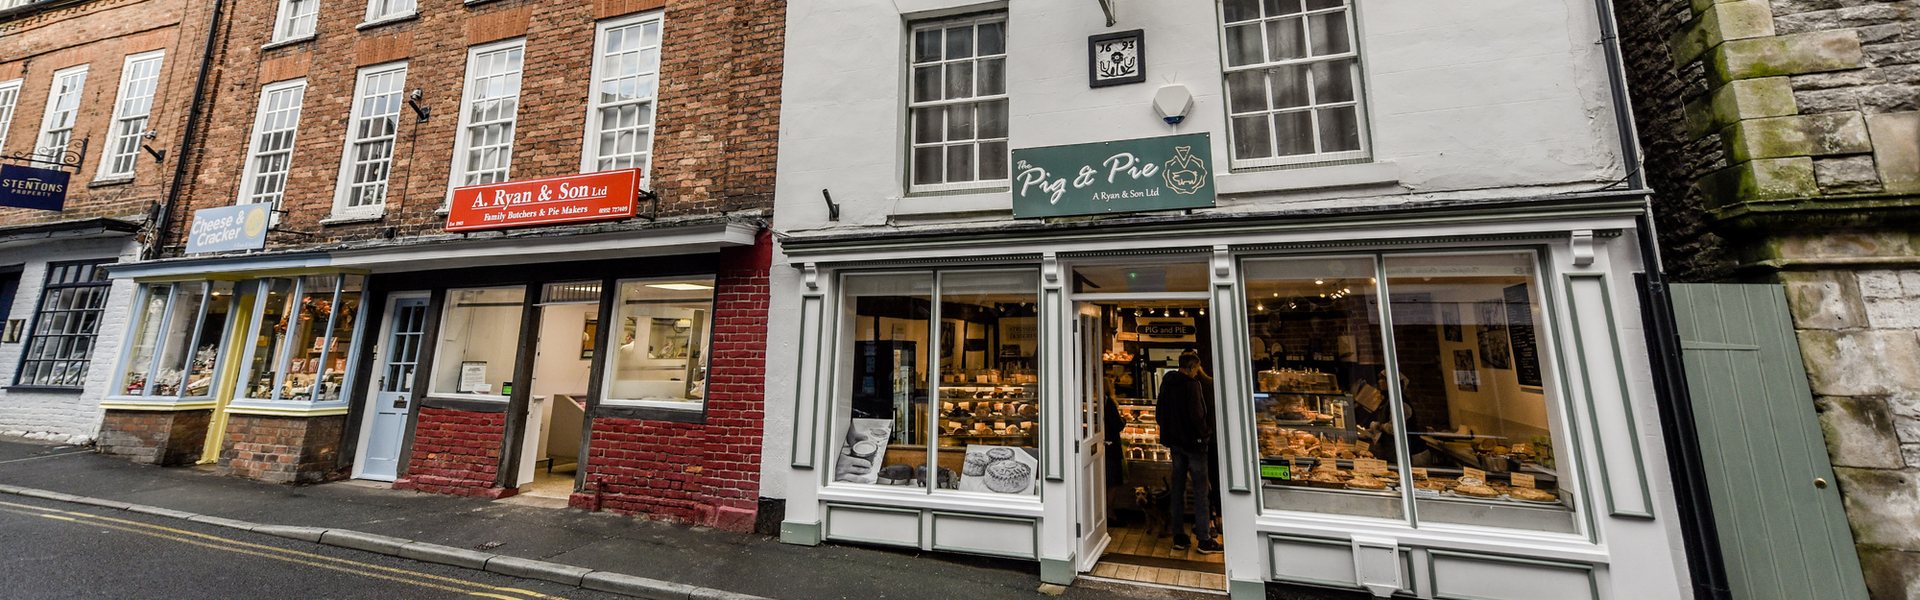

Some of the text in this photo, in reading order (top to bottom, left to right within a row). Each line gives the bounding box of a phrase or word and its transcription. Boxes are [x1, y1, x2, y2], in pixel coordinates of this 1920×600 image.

[1016, 159, 1033, 170] The
[2, 178, 63, 193] STENTONS
[1017, 152, 1159, 205] Pig & Pie
[10, 188, 52, 197] PROPERTY
[471, 182, 608, 210] A. Ryan & Son Ltd
[1092, 192, 1100, 200] A
[1101, 191, 1120, 202] Ryan
[1129, 189, 1144, 198] Son
[1146, 187, 1160, 197] Ltd
[483, 205, 588, 222] Family Butchers & Pie Makers
[192, 209, 245, 235] Cheese &
[196, 226, 241, 246] Cracker
[1145, 326, 1158, 334] PIG
